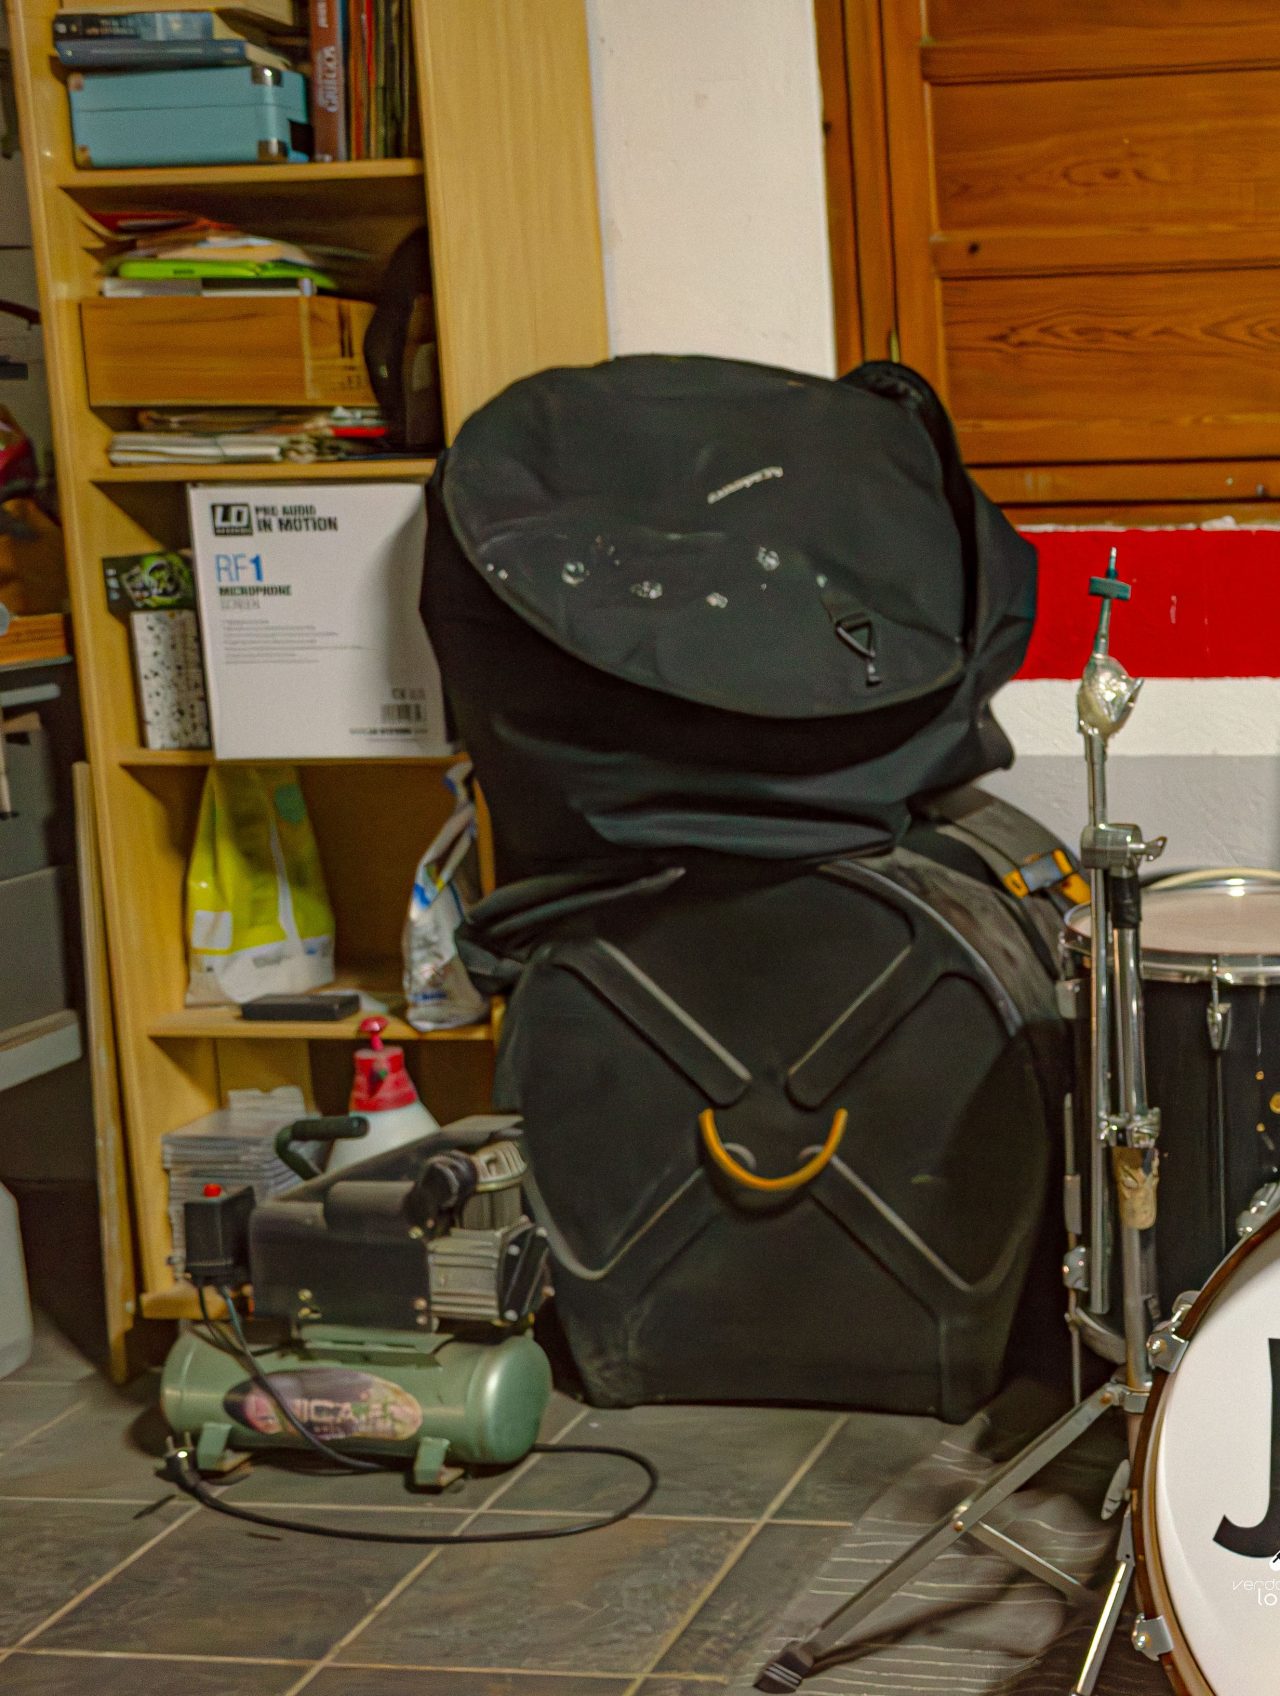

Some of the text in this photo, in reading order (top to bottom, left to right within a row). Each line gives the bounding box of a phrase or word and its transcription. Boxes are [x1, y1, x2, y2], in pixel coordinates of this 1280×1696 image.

[256, 518, 273, 532] IN
[278, 517, 338, 532] MOTION
[214, 553, 264, 582] RF1
[218, 585, 292, 597] MICROPHONE
